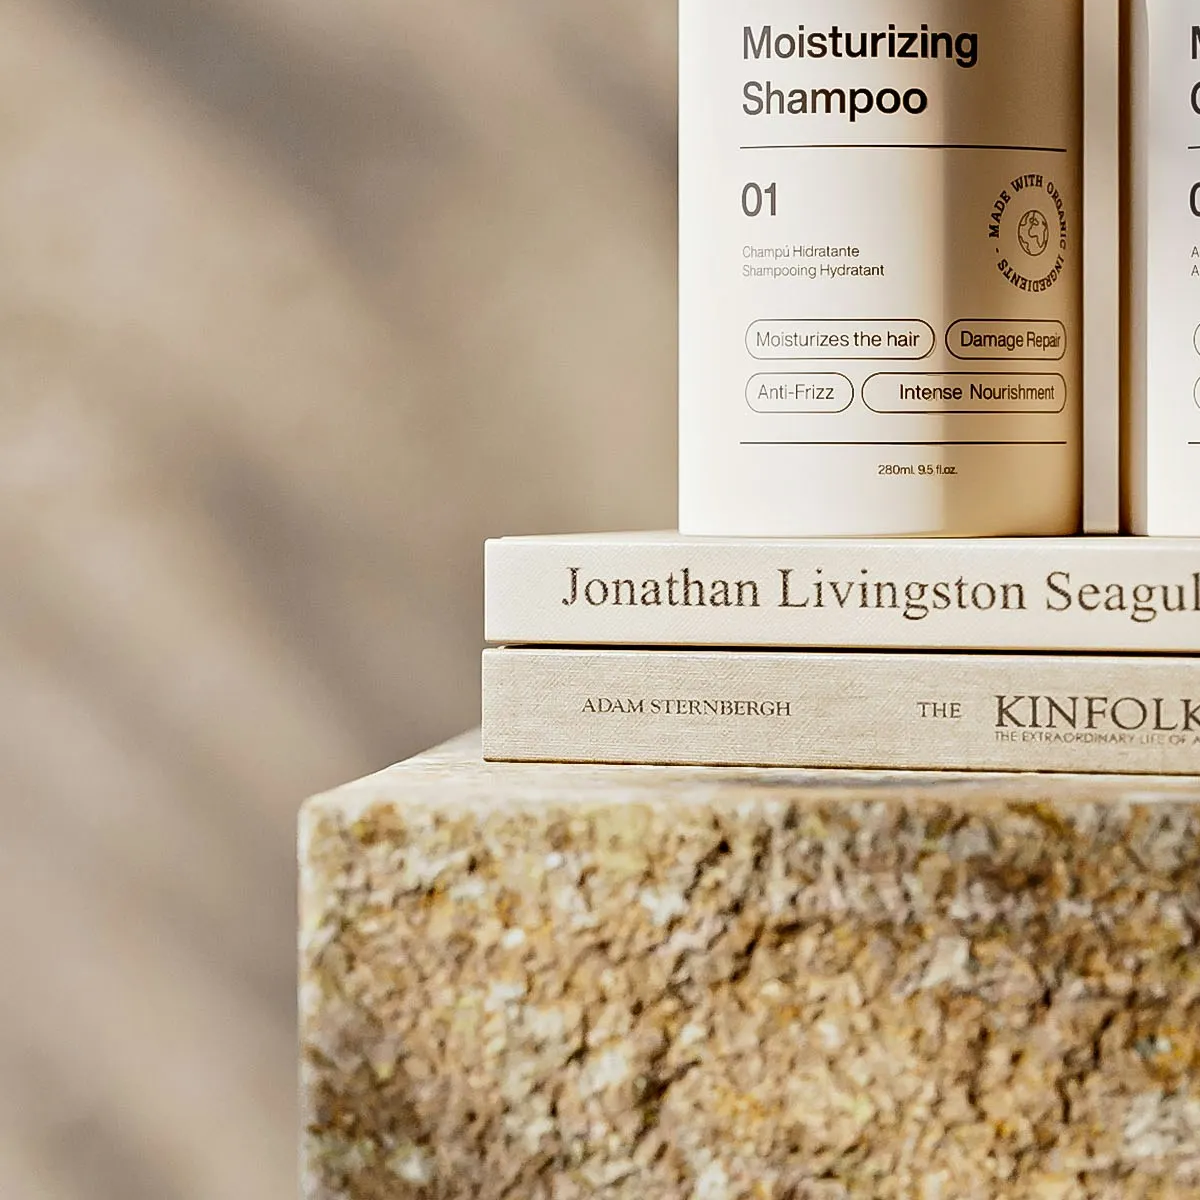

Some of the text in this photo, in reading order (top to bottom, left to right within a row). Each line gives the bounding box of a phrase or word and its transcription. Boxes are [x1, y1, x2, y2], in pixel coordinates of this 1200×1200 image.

[743, 23, 979, 68] Moisturizing
[742, 81, 928, 122] Shampoo
[741, 182, 777, 217] 01
[989, 174, 1067, 292] MADE WITH ORGANIC INGREDIENTS
[742, 245, 860, 260] Champú Hidratante
[742, 264, 885, 279] Shampooing Hydratant
[756, 331, 920, 348] Moisturizes the hair
[960, 330, 1061, 351] Damage Repair
[757, 384, 835, 400] Anti-Frizz
[900, 383, 1055, 400] Intense Nourishment
[561, 567, 760, 608] Jonathan
[777, 568, 1027, 620] Livingston
[581, 698, 792, 717] ADAM STERNBERGH
[917, 702, 962, 719] THE
[995, 731, 1019, 742] THE
[1022, 731, 1134, 745] EXTRAORDINARY
[1140, 733, 1166, 745] LIFE
[1168, 734, 1187, 746] OF
